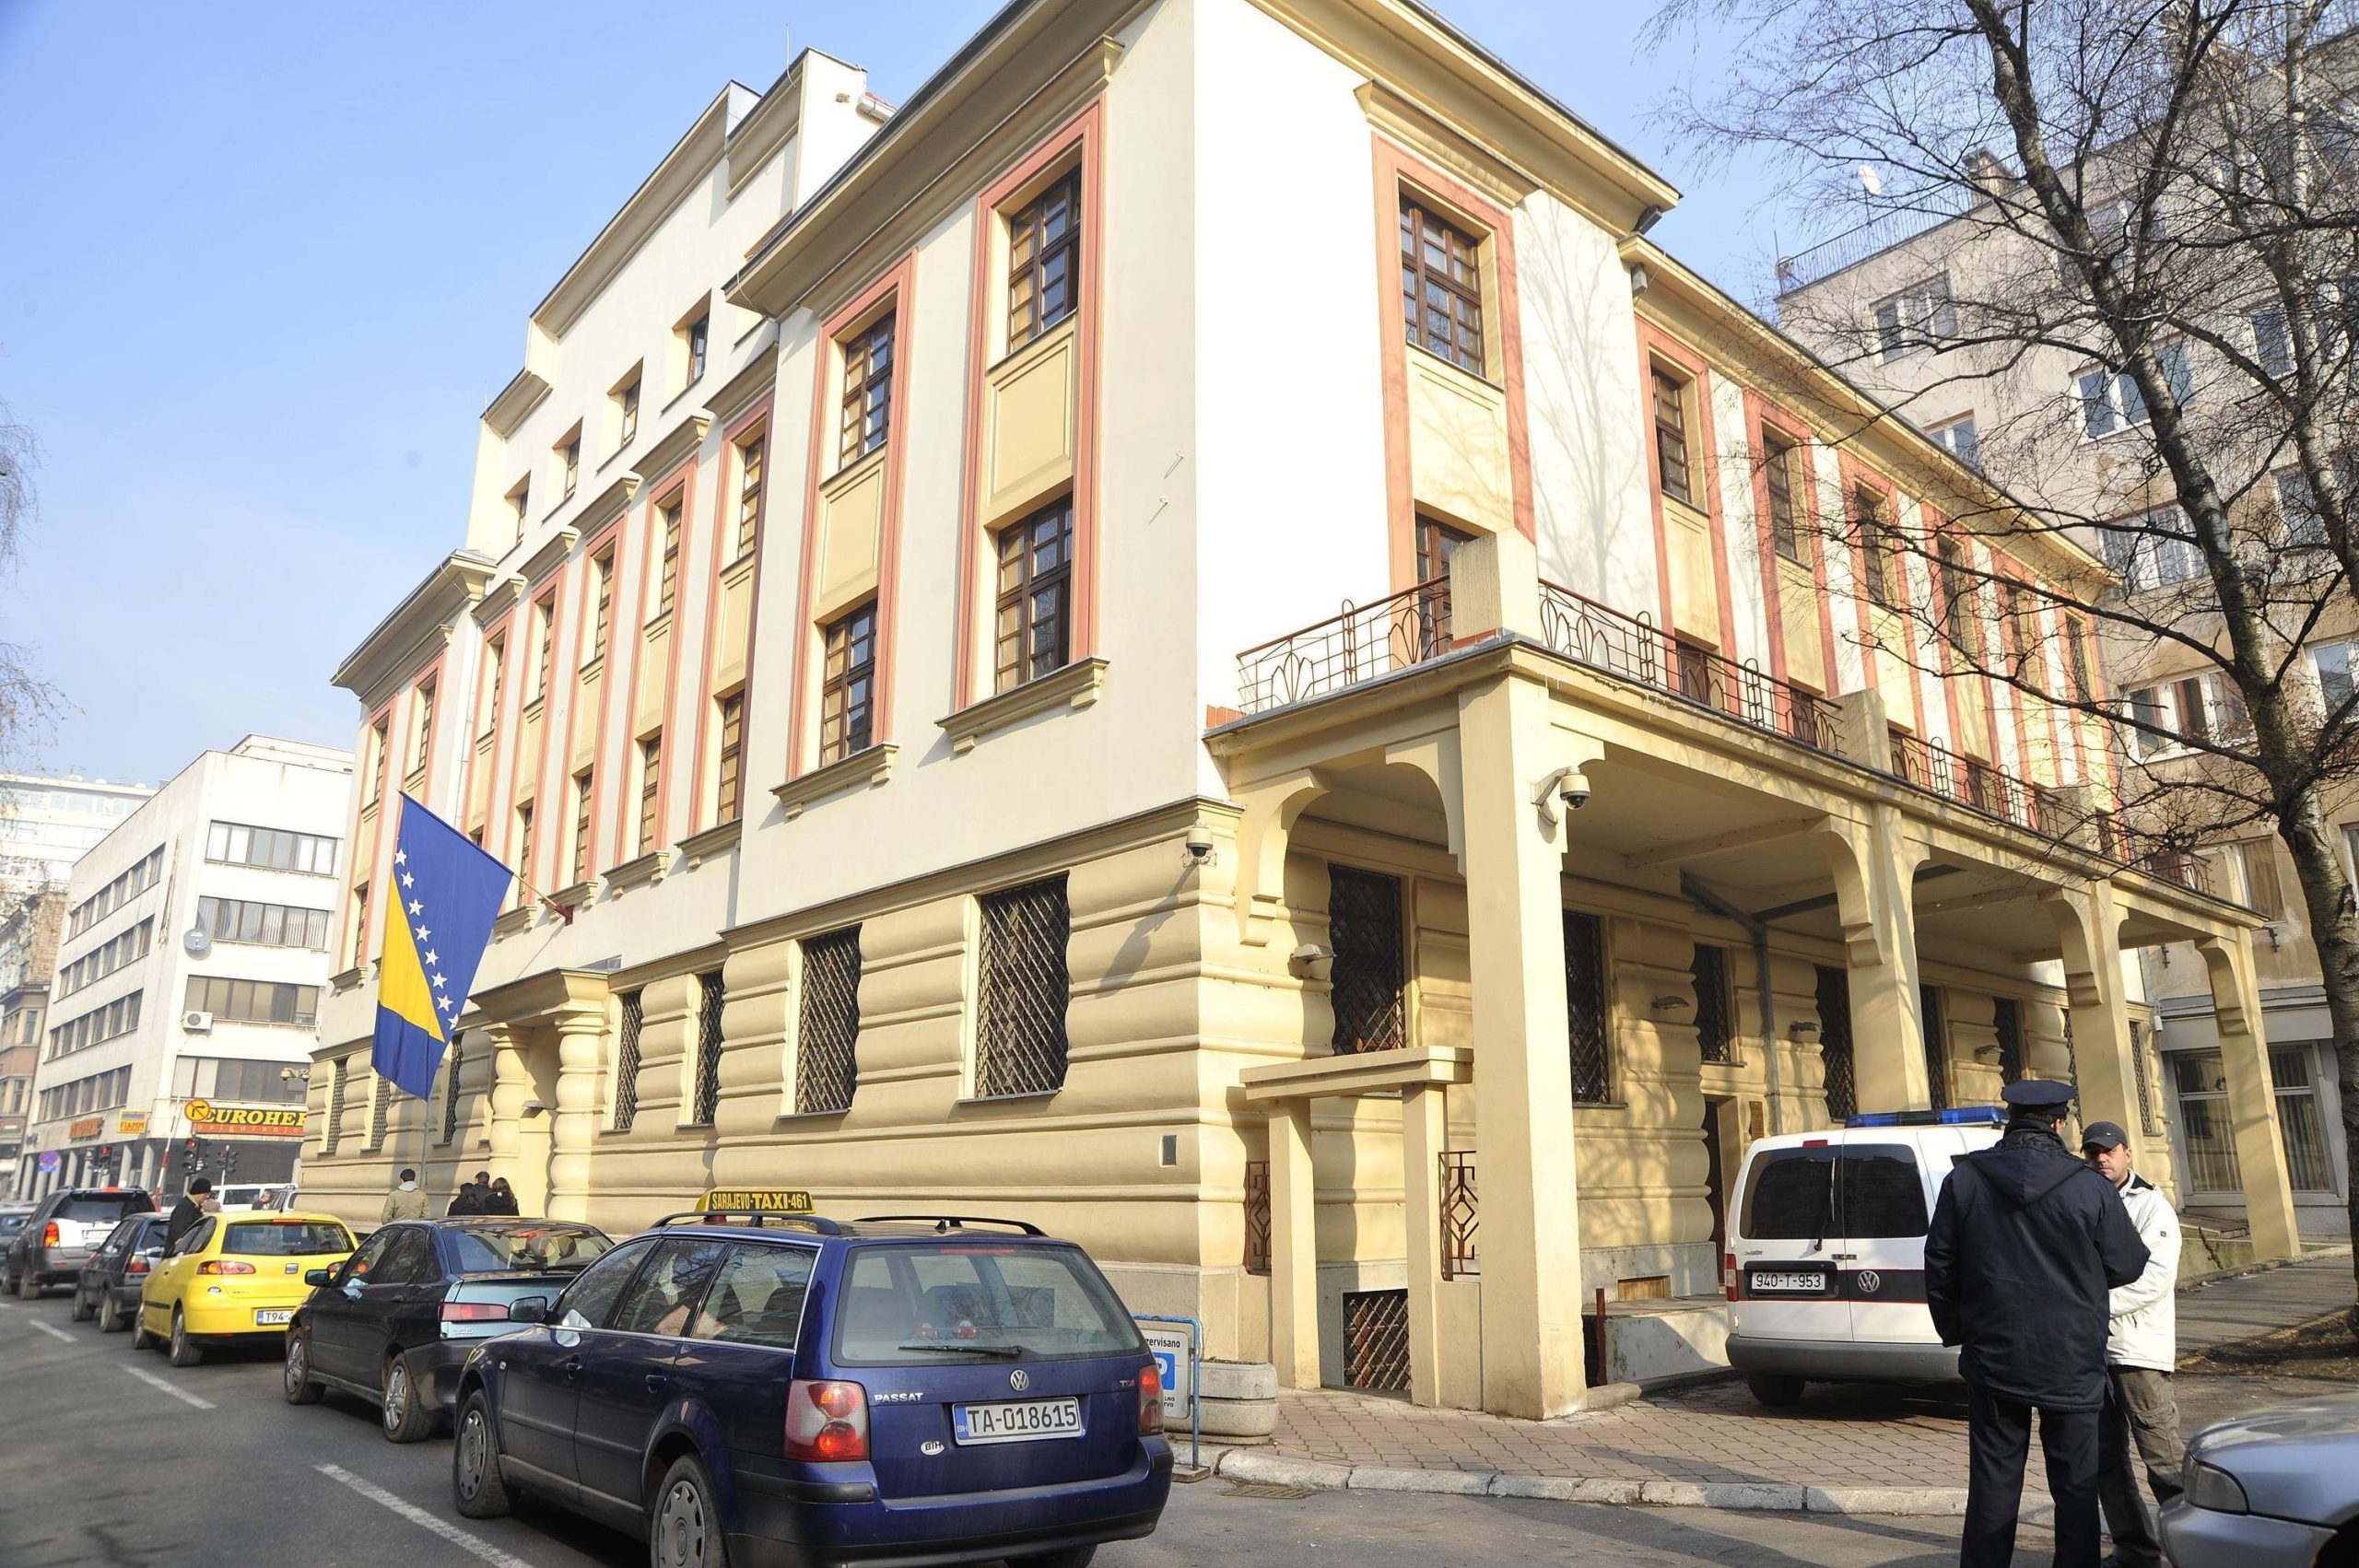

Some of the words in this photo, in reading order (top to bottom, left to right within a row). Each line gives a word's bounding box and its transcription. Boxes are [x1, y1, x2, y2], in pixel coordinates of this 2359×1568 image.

[120, 1121, 145, 1129] FIAMM
[712, 1193, 750, 1210] SARAJEVO
[751, 1192, 789, 1210] TAXI
[791, 1193, 808, 1209] 461
[1756, 1274, 1821, 1288] 940-T-953
[874, 1392, 923, 1403] PASSAT
[968, 1404, 1076, 1433] TA-018615
[925, 1441, 942, 1451] BIH
